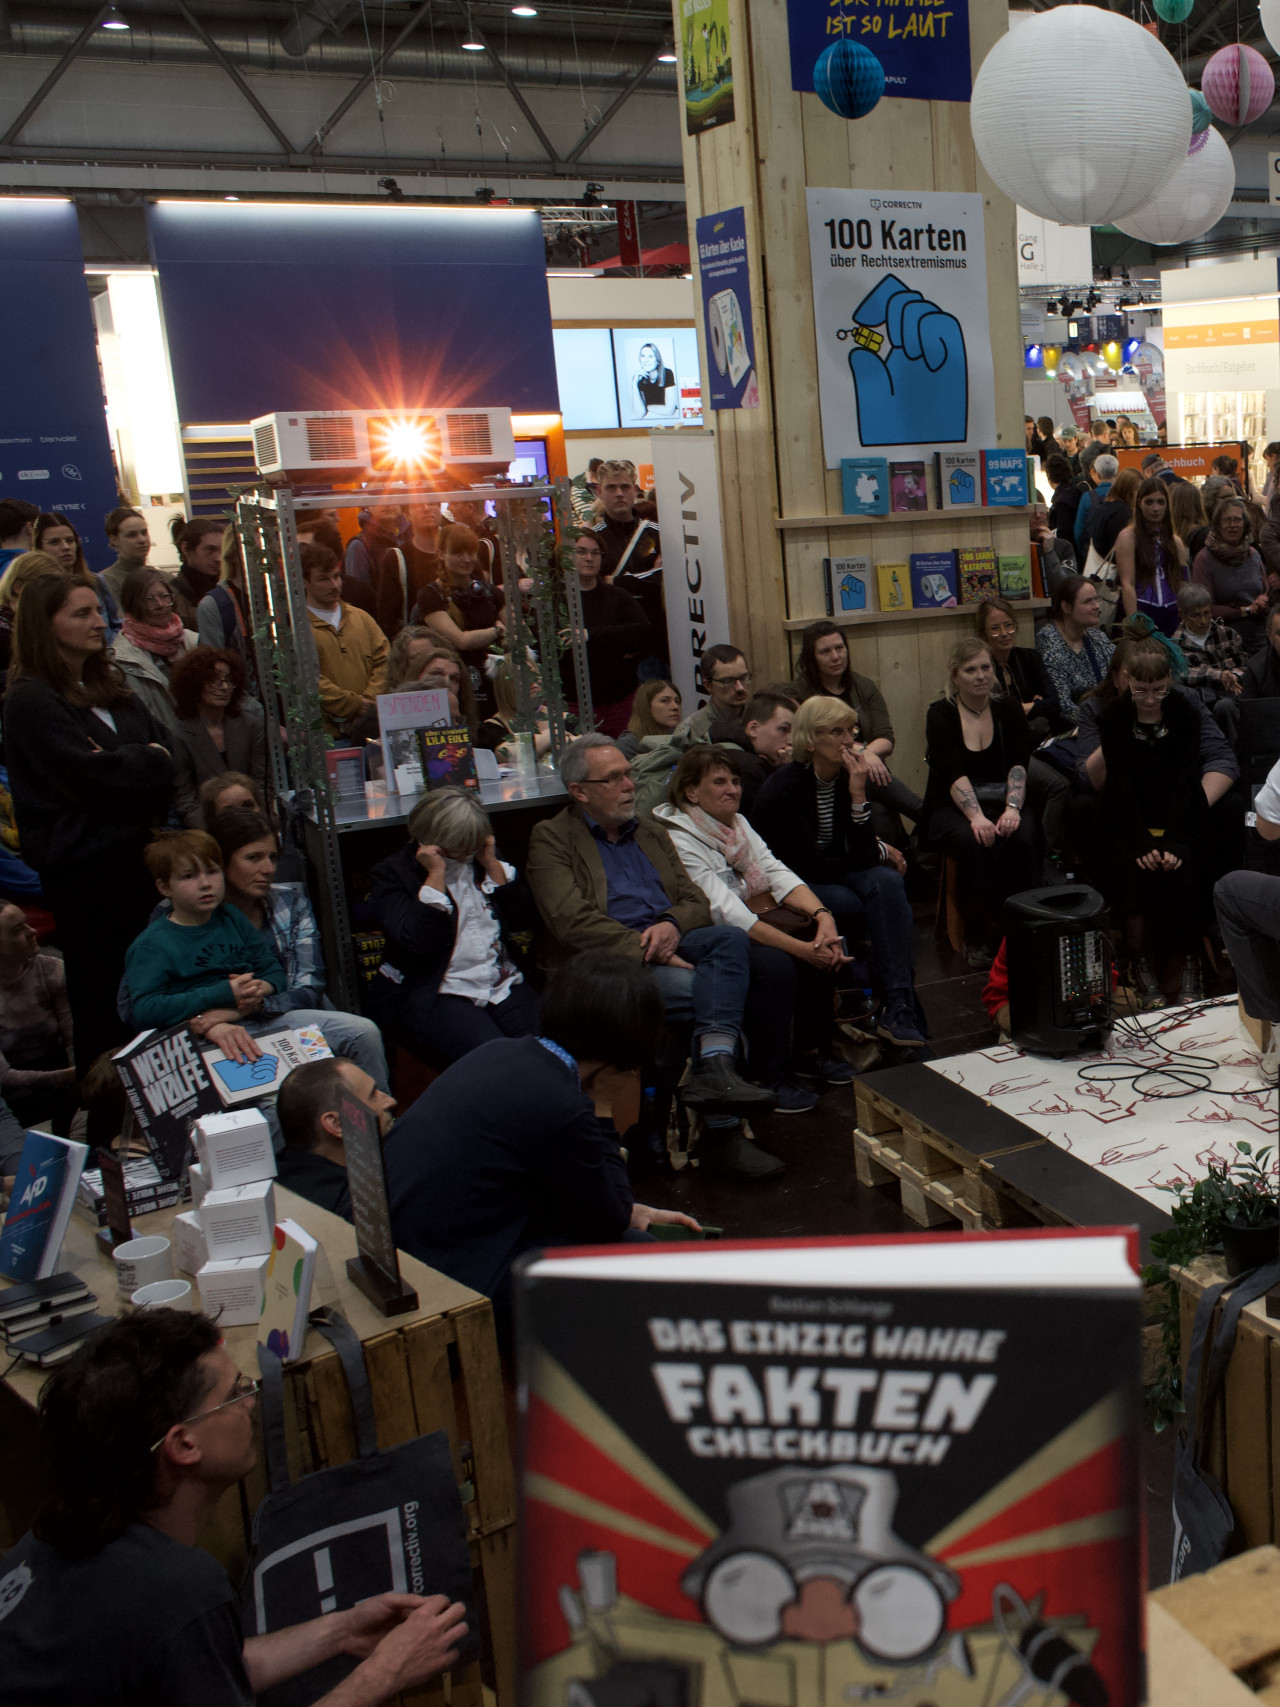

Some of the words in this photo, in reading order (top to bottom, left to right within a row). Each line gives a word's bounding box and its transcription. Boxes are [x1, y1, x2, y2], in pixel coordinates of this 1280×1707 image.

[826, 15, 856, 34] IST
[861, 16, 882, 34] SO
[888, 11, 953, 39] LAUT
[884, 76, 907, 84] APULT
[882, 200, 922, 209] CORRECTIV
[824, 218, 872, 249] 100
[881, 220, 967, 251] Karten
[1019, 233, 1038, 243] Gang
[1020, 243, 1034, 260] G
[830, 254, 856, 267] über
[861, 254, 967, 268] Rechtsextremismus
[1020, 262, 1038, 270] Halle
[988, 460, 999, 469] 99
[1000, 459, 1023, 469] MAPS
[847, 562, 866, 570] Karten
[678, 471, 707, 710] RRECTIV
[383, 693, 441, 718] SPENDEN
[425, 736, 446, 746] LILA
[448, 733, 470, 743] EULE
[277, 1037, 293, 1057] 100
[648, 1318, 726, 1354] DAS
[729, 1321, 866, 1358] EINZIG
[871, 1328, 1007, 1364] WAHRE
[650, 1362, 998, 1434] FAKTEN
[686, 1428, 954, 1467] CHECKBUCH
[403, 1499, 425, 1594] correctiv.org
